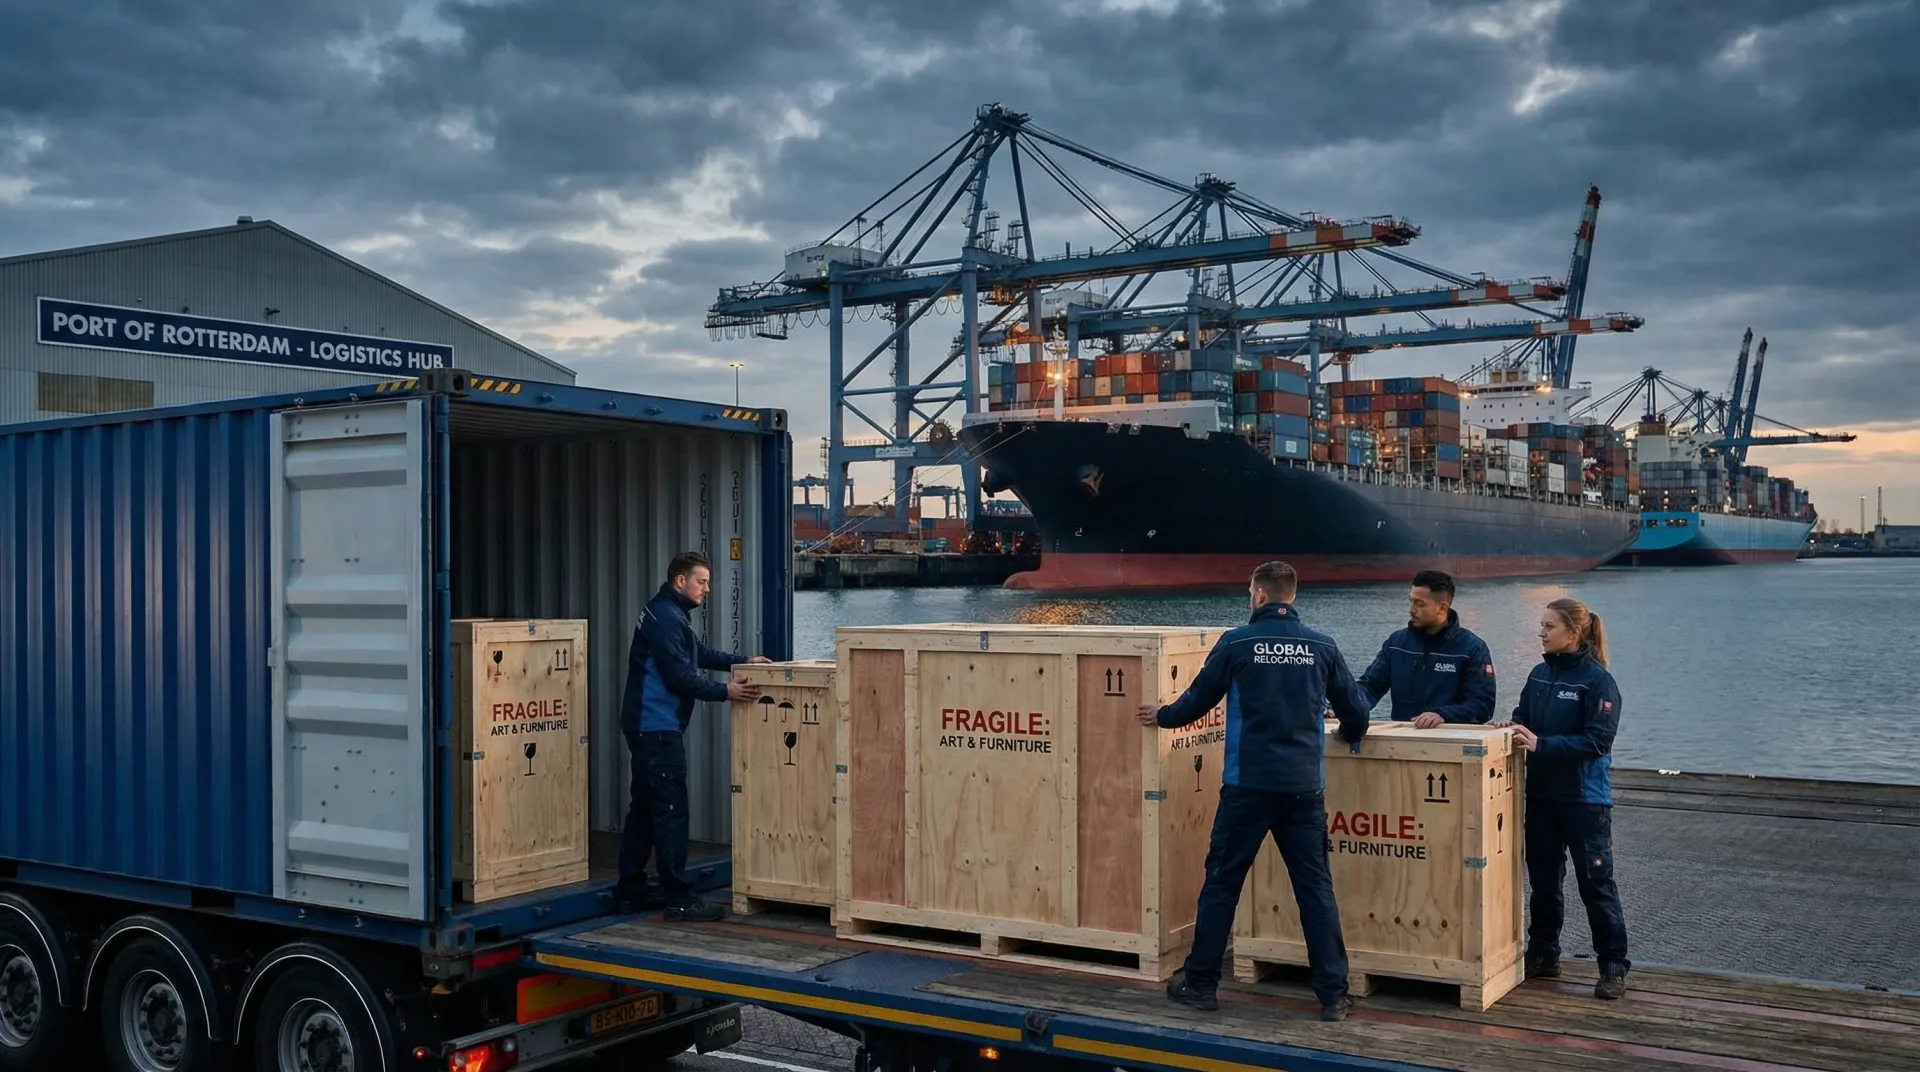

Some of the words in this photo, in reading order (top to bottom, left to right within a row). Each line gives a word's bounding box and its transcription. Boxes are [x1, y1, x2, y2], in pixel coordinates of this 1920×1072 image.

[53, 311, 117, 338] PORT
[124, 320, 154, 341] OF
[163, 324, 291, 356] ROTTERDAM
[310, 341, 403, 367] LOGISTICS
[408, 351, 444, 369] HUB
[1253, 642, 1314, 656] GLOBAL
[1253, 655, 1315, 665] RELOCATIONS
[492, 699, 567, 722] FRAGILE:
[490, 725, 509, 737] ART
[511, 724, 518, 735] &
[520, 719, 568, 734] FURNITURE
[942, 708, 1050, 736] FRAGILE:
[939, 735, 964, 748] ART
[967, 737, 976, 749] &
[979, 737, 1052, 754] FURNITURE
[1171, 738, 1184, 751] ART
[1191, 729, 1225, 748] FURNITURE
[1324, 810, 1424, 841] AGILE:
[1339, 840, 1426, 860] FURNITURE
